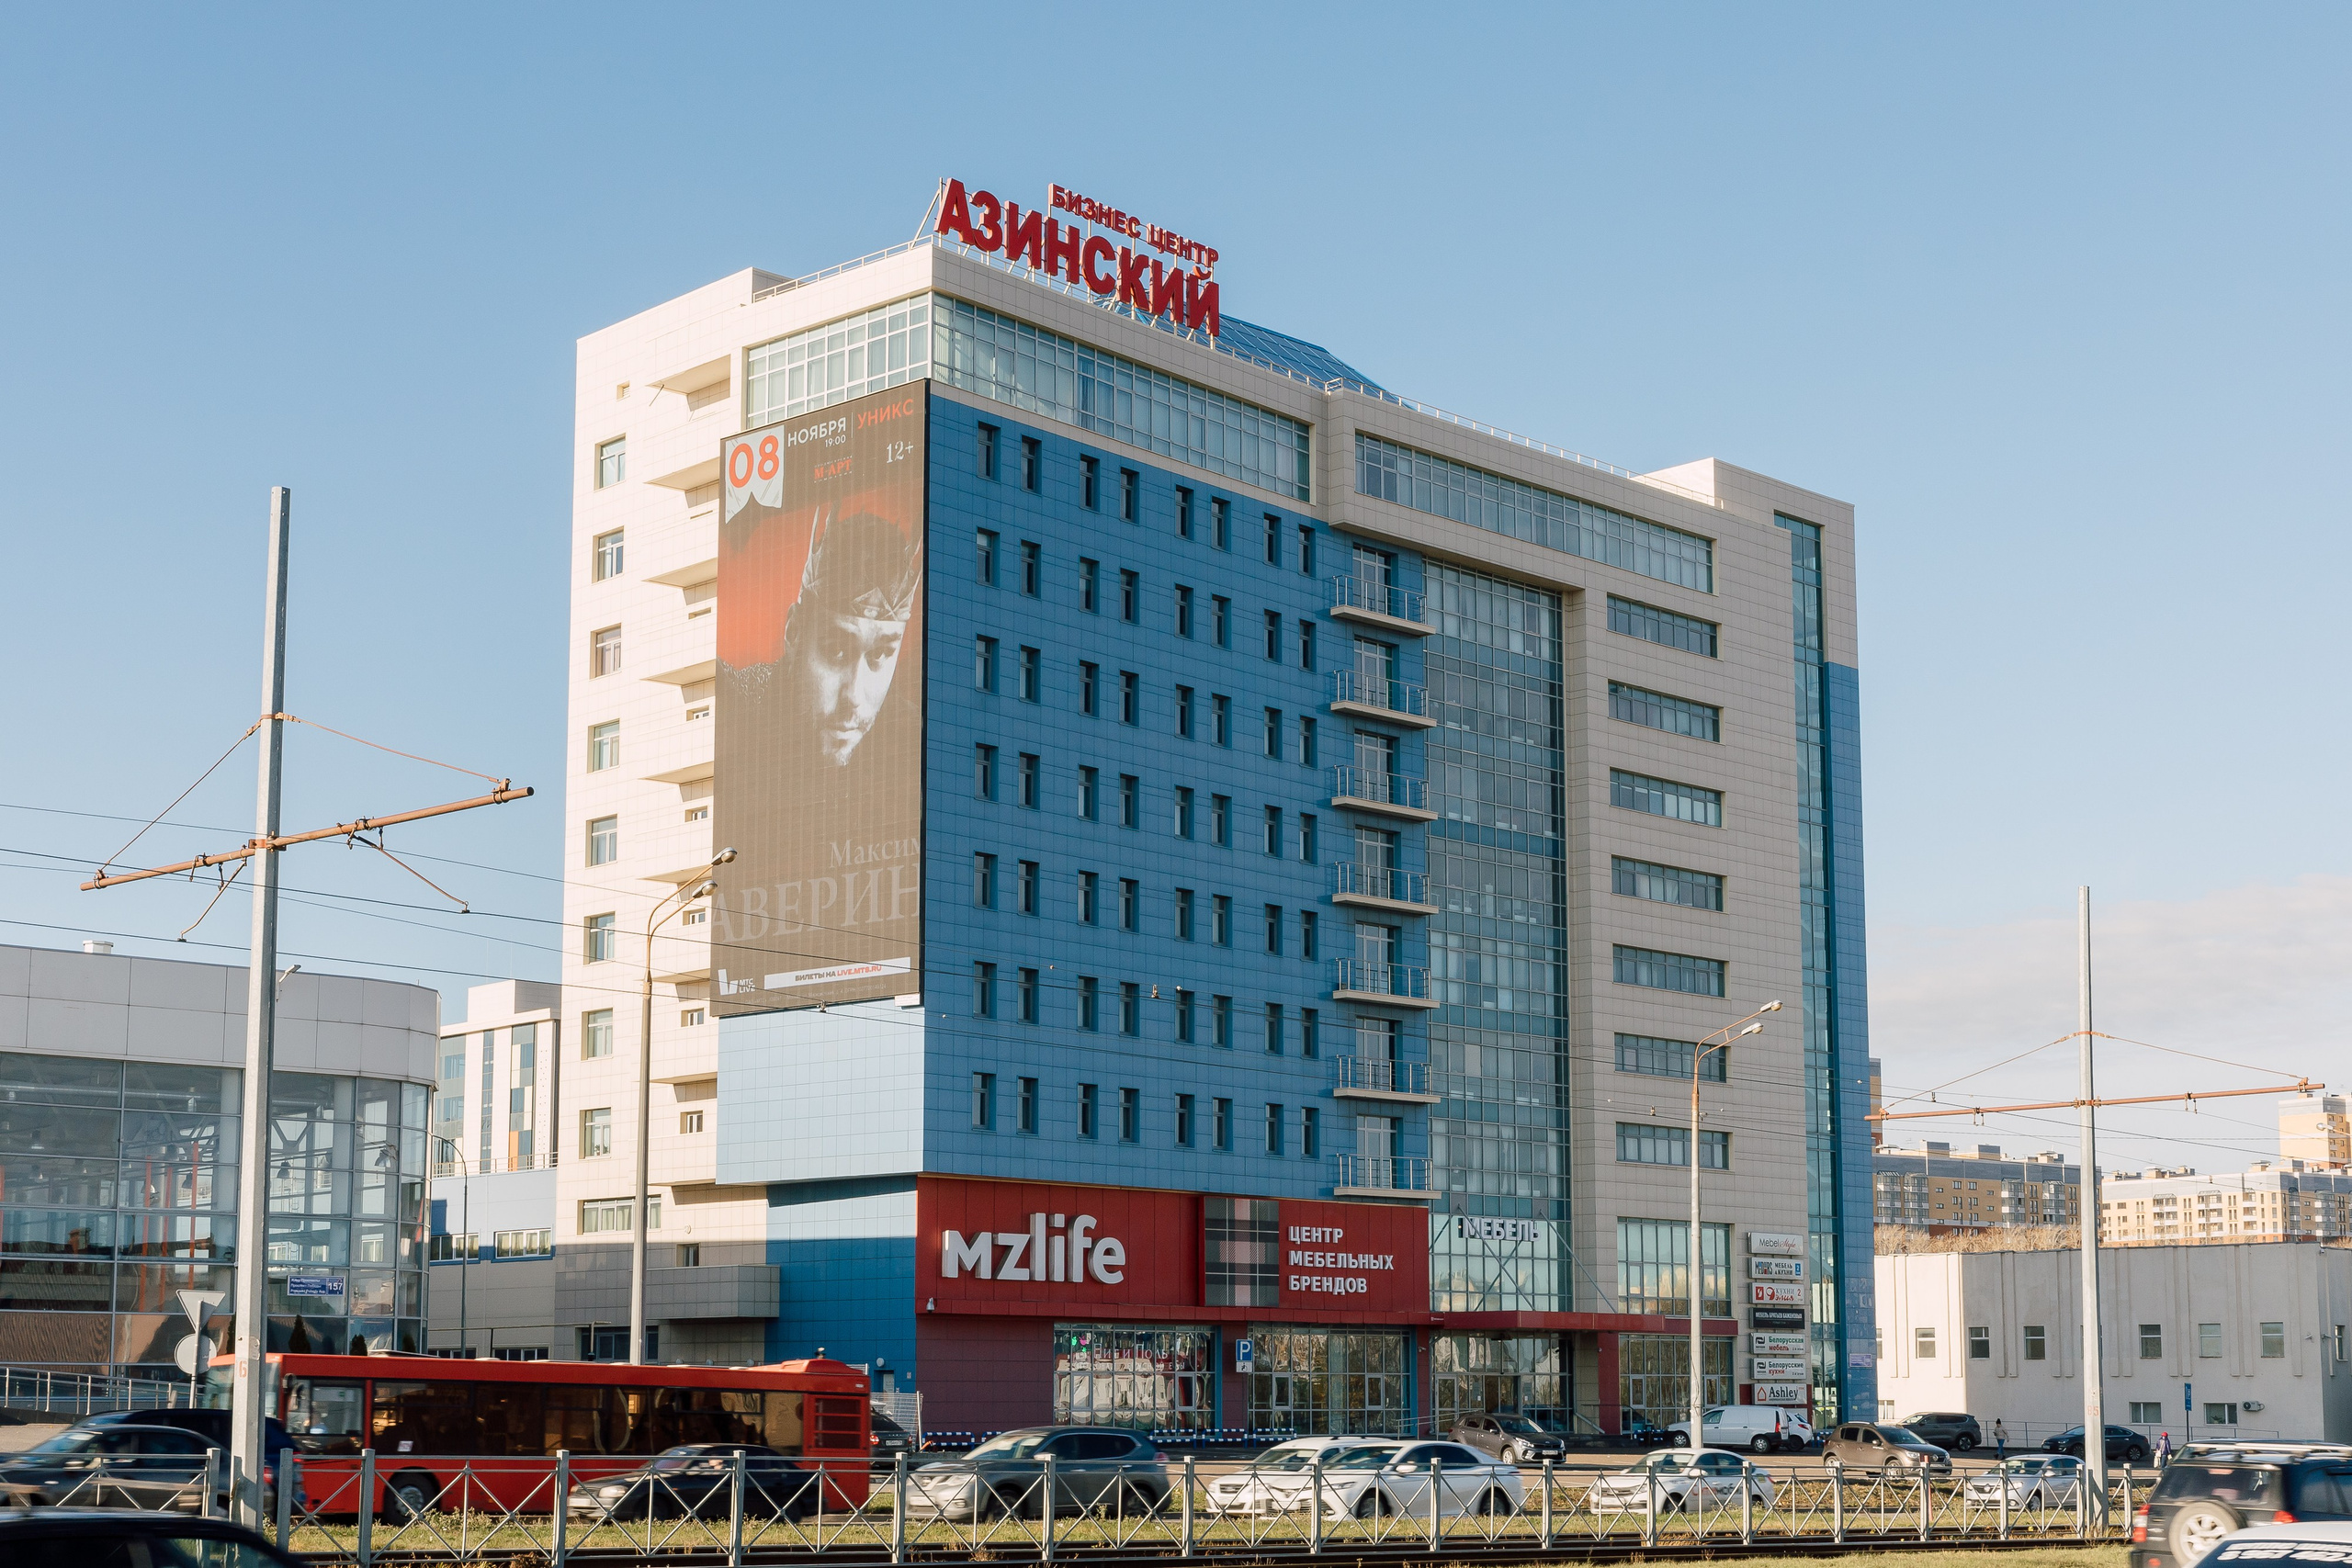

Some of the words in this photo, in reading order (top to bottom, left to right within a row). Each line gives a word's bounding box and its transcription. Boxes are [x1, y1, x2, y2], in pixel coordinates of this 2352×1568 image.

[1049, 183, 1141, 239] БИЗНЕС
[1147, 222, 1219, 268] ЦЕНТР
[933, 177, 1220, 337] АЗИНСКИЙ
[729, 434, 780, 489] 08
[787, 416, 846, 447] НОЯБРЯ
[857, 398, 914, 430] УНИКС
[825, 434, 846, 448] 19:00
[886, 440, 914, 464] 12+
[712, 863, 920, 944] АВЕРИН
[795, 971, 825, 982] БИЛЕТЫ
[825, 970, 836, 978] НА
[739, 984, 756, 994] LIVE
[1288, 1225, 1344, 1246] ЦЕНТР
[1463, 1217, 1541, 1242] МЕБЕЛЬ
[1758, 1237, 1780, 1247] Mebel
[1288, 1250, 1395, 1270] МЕБЕЛЬНЫХ
[328, 1282, 343, 1291] 157
[1288, 1274, 1368, 1296] БРЕНДОВ
[1769, 1336, 1804, 1345] Белорусская
[1768, 1360, 1804, 1370] Белорусские
[1769, 1386, 1799, 1401] Ashley
